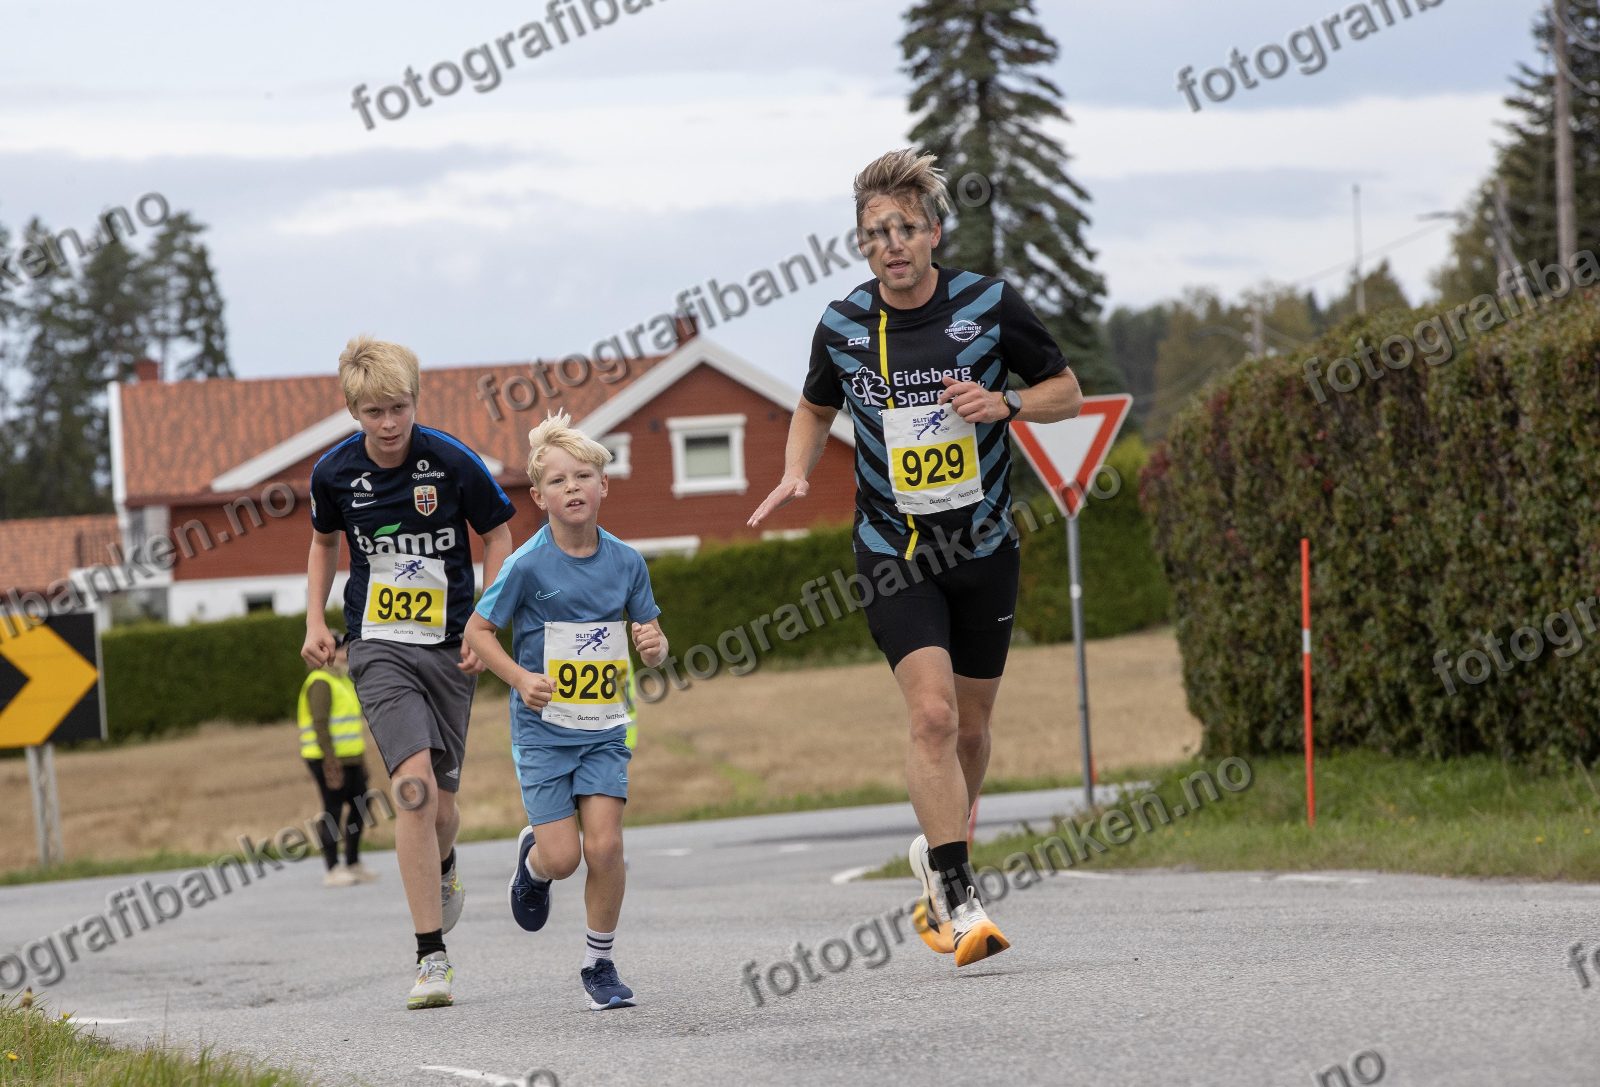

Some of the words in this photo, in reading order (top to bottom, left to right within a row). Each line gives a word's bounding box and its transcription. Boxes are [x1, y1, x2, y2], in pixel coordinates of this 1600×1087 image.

[893, 366, 972, 387] Eidsberg
[412, 471, 445, 480] Gjensidige
[902, 444, 964, 487] 929
[354, 526, 456, 554] bama
[377, 588, 433, 622] 932
[558, 663, 618, 699] 928
